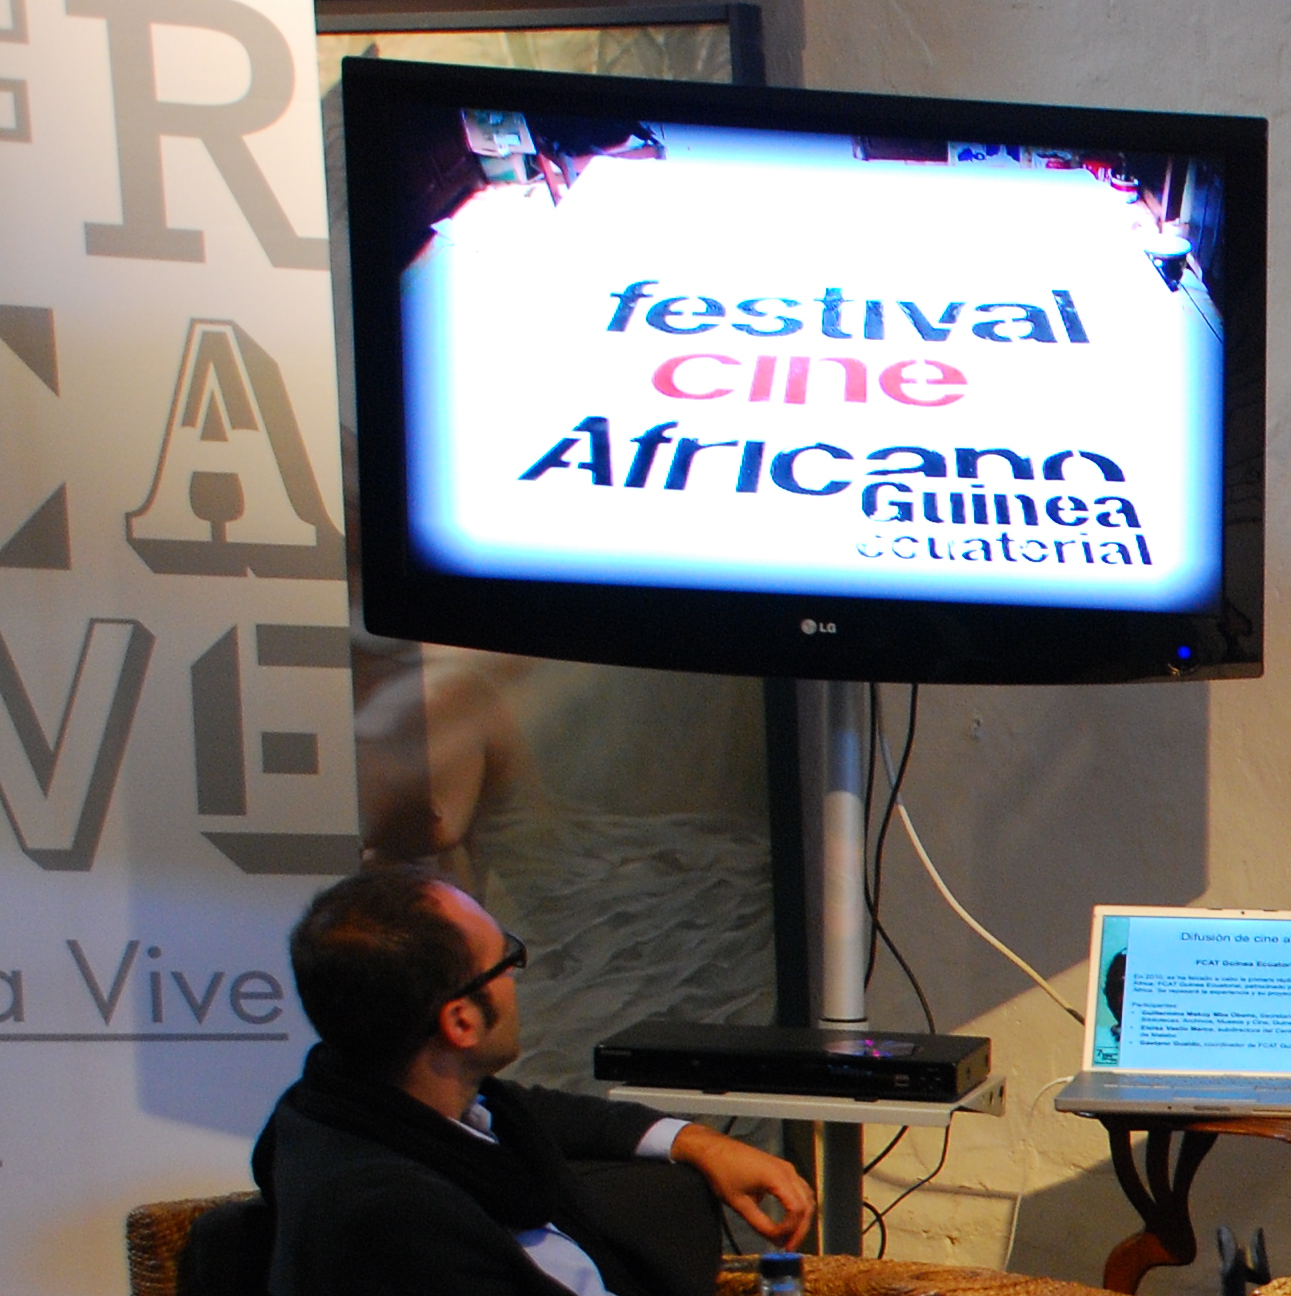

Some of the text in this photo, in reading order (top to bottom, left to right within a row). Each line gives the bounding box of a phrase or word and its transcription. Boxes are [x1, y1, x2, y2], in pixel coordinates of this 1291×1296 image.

[606, 281, 1091, 344] festival
[651, 353, 969, 407] cine
[518, 416, 1126, 496] Africano
[861, 481, 1141, 530] Guinea
[858, 532, 1154, 566] ecuatorial
[819, 622, 837, 633] LG
[1181, 931, 1231, 942] Difusión
[1234, 933, 1250, 942] de
[1254, 934, 1279, 943] cine
[66, 939, 284, 1026] Vive
[1195, 959, 1219, 967] FCAT
